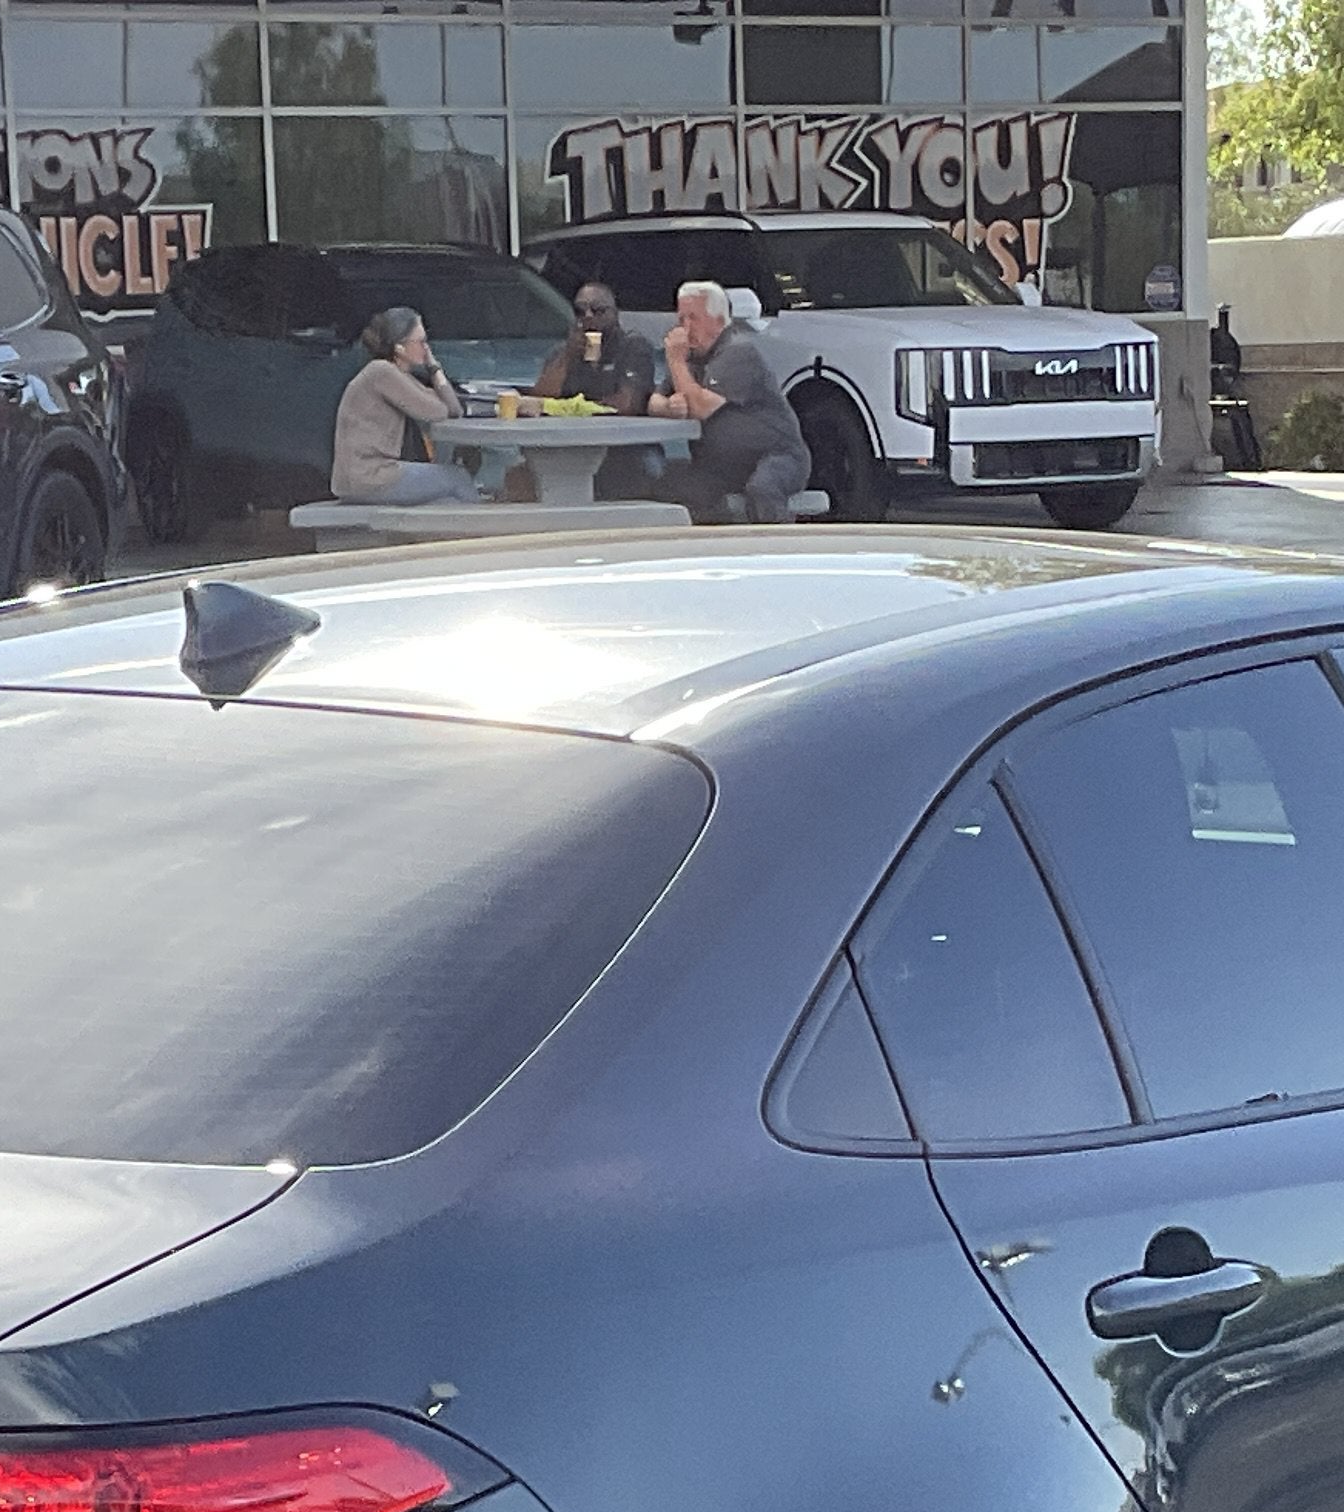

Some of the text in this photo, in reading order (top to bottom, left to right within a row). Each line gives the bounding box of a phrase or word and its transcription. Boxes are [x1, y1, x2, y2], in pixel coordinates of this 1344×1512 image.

[561, 112, 1071, 217] THANK YOU!
[1035, 359, 1078, 375] KIA
